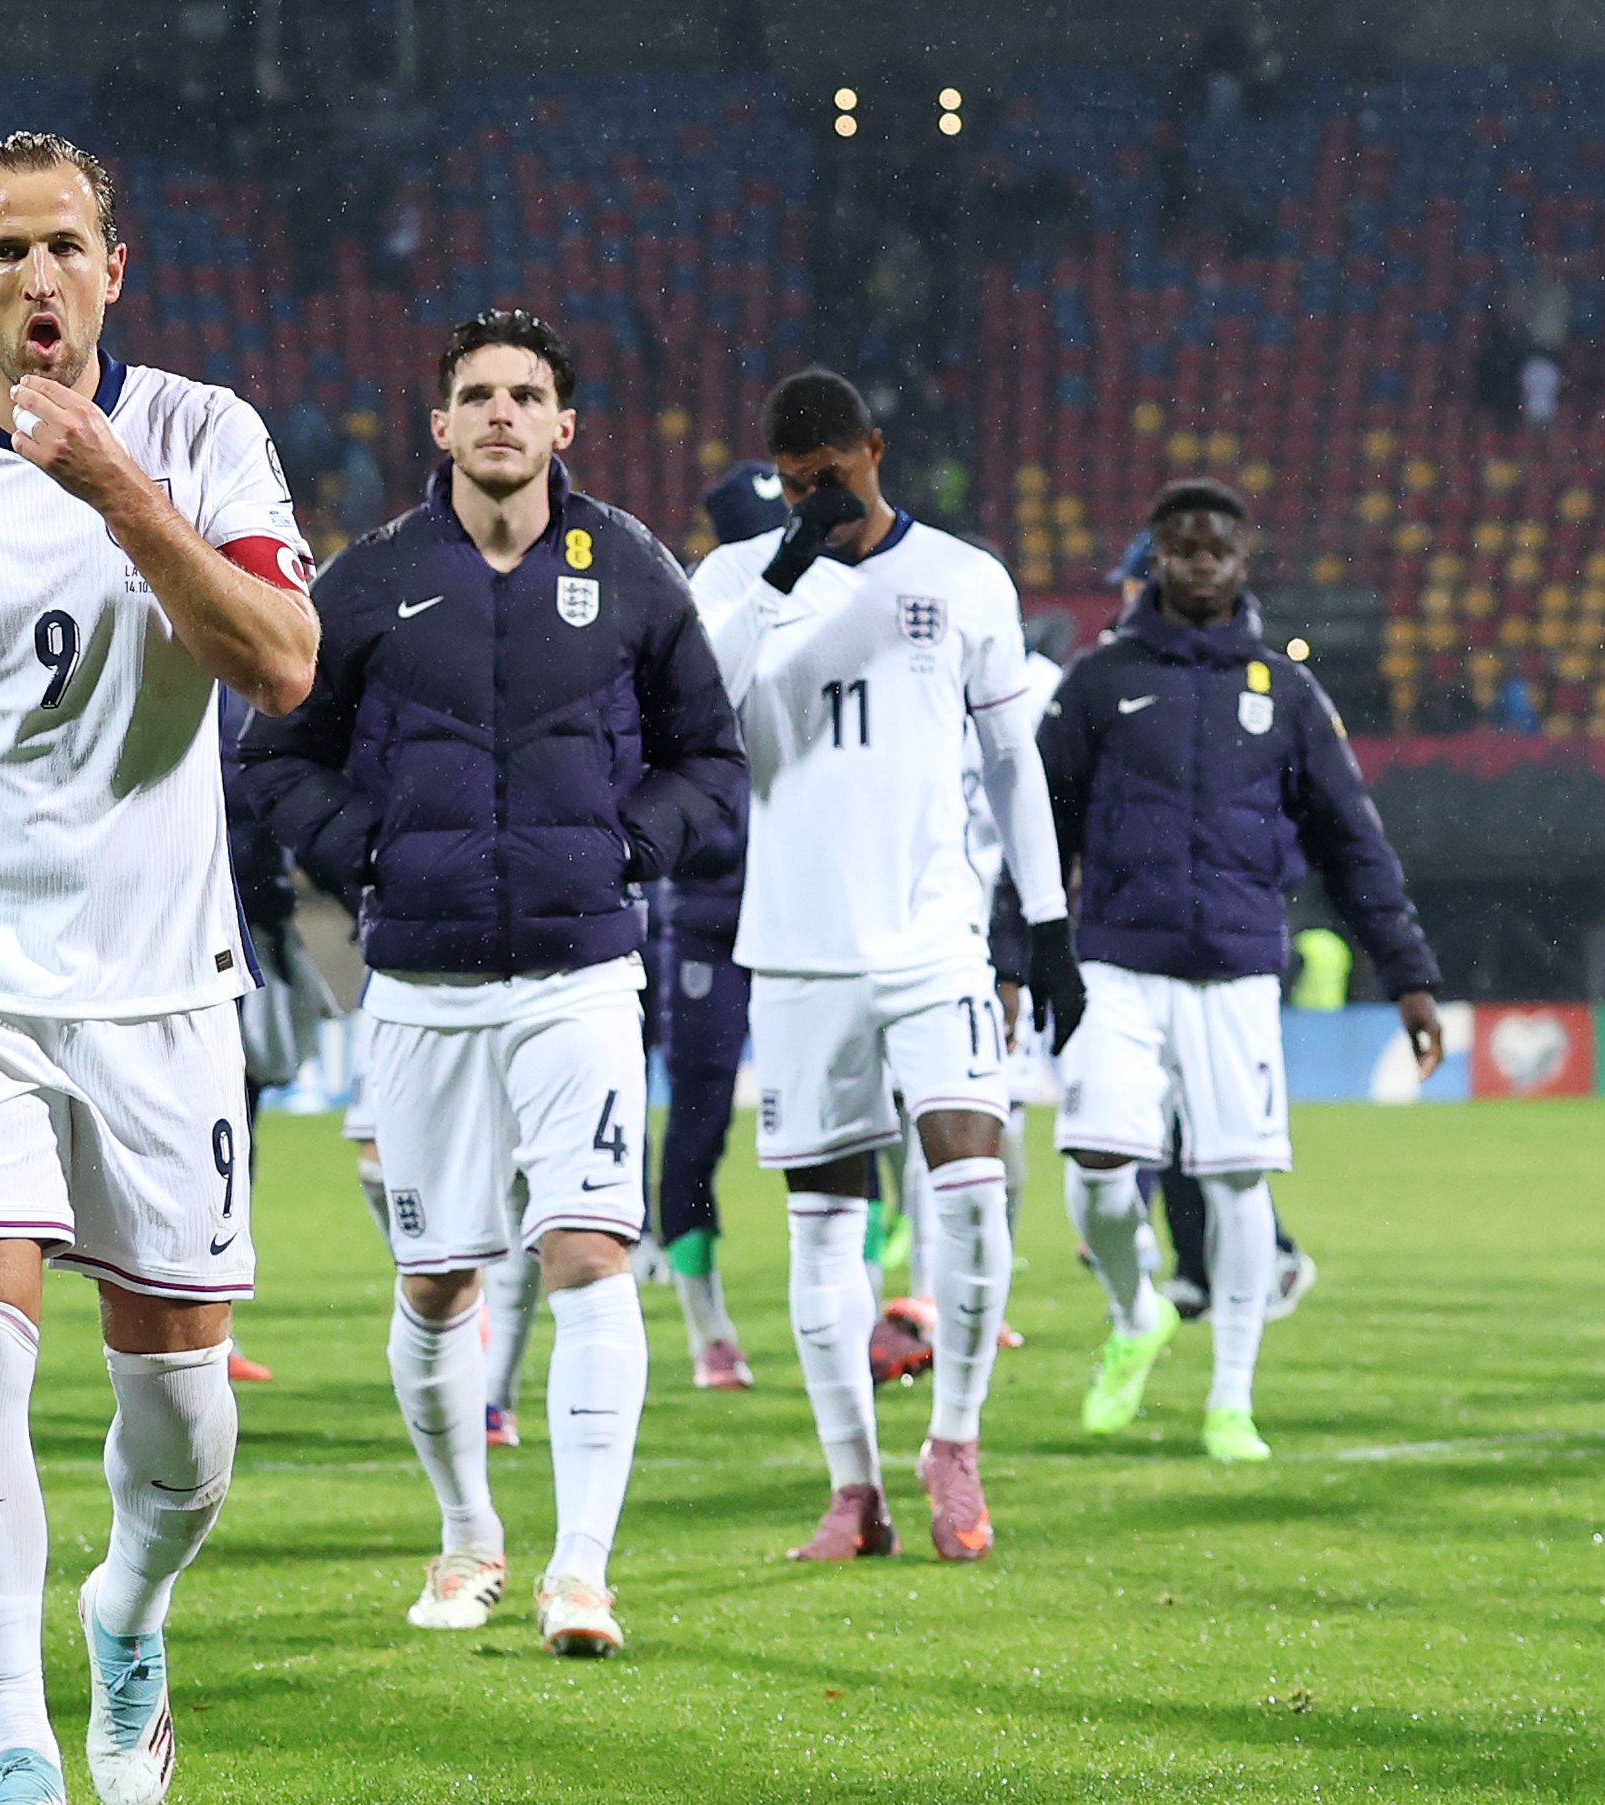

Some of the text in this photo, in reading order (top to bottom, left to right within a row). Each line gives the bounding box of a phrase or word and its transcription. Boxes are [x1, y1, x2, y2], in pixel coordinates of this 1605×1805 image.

[124, 580, 153, 593] 14.10.
[125, 564, 139, 577] LA
[34, 609, 80, 709] 9
[821, 680, 869, 750] 11
[958, 996, 1001, 1062] 11
[593, 1088, 628, 1166] 4
[212, 1118, 235, 1219] 9
